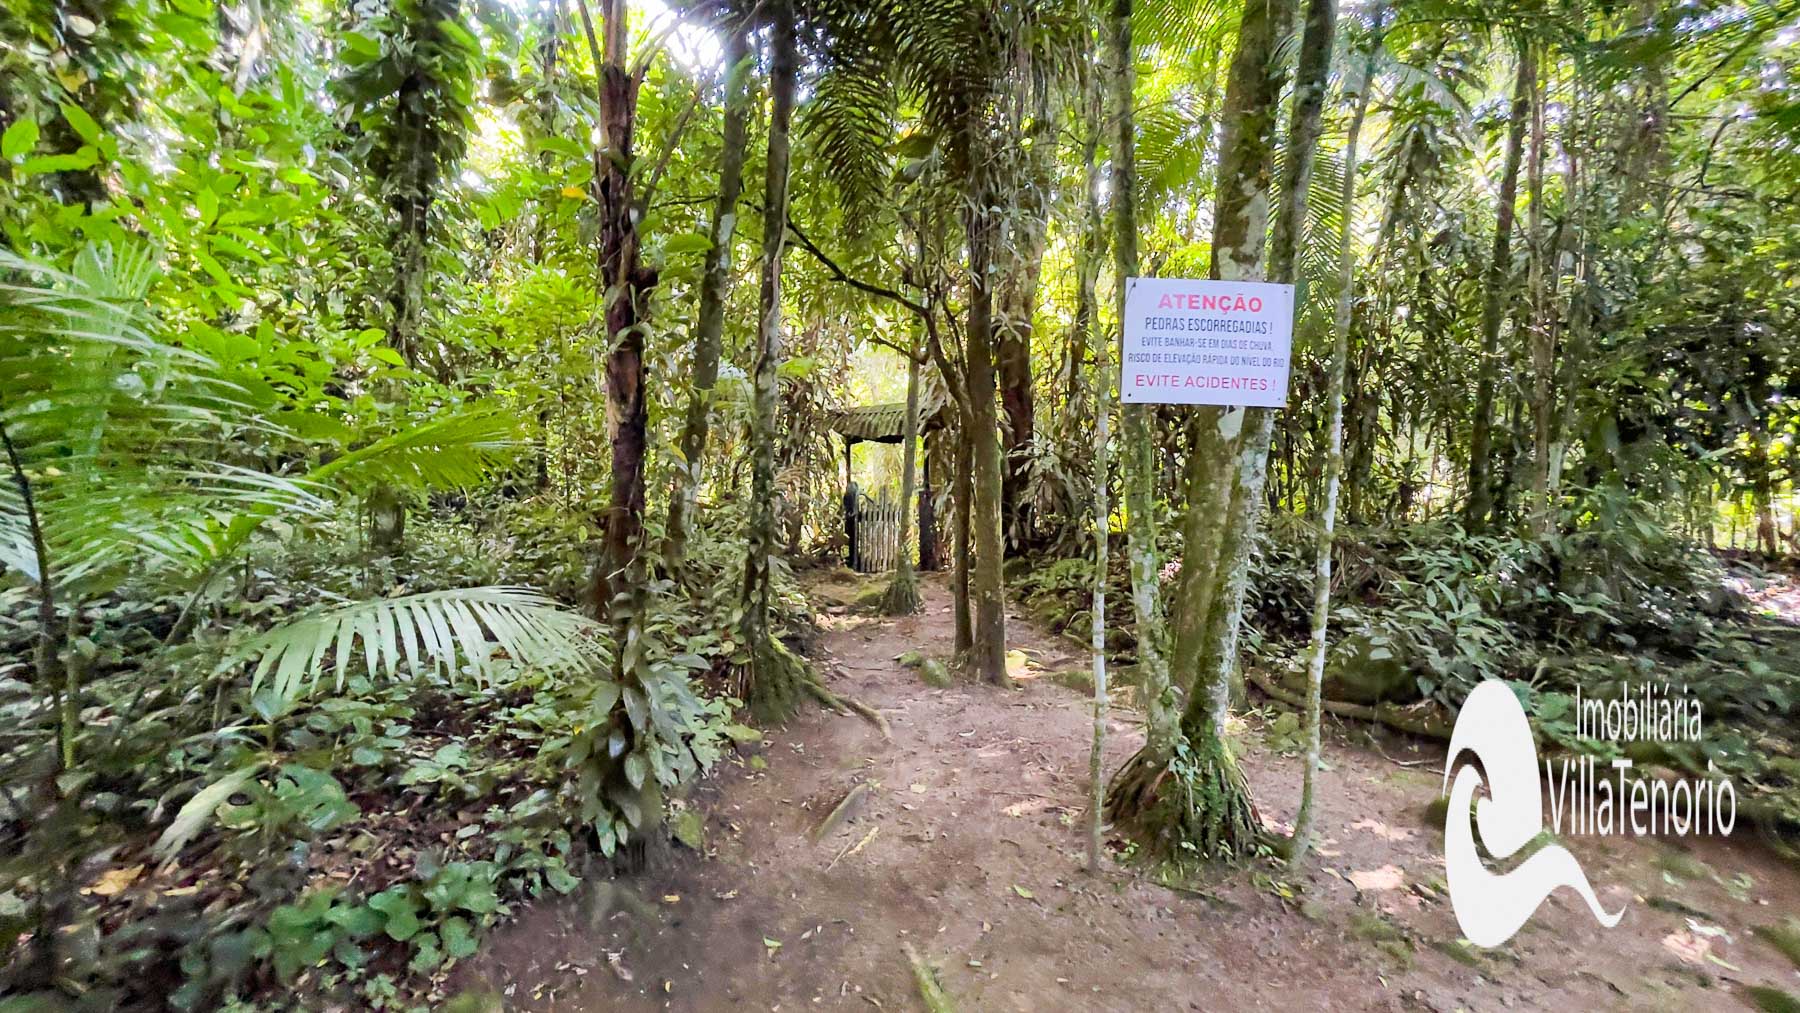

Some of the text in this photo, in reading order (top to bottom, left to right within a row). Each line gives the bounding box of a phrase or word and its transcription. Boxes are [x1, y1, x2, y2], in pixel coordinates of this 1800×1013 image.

[1158, 293, 1262, 315] ATENÇÃO
[1145, 317, 1185, 331] PEDRAS
[1188, 318, 1267, 334] ESCORREGADIAS
[1141, 337, 1163, 347] EVITE
[1165, 337, 1206, 348] BANHAR-SE
[1208, 338, 1219, 349] EM
[1221, 339, 1237, 349] DIAS
[1239, 339, 1248, 350] DE
[1128, 352, 1150, 363] RISCO
[1152, 353, 1162, 363] DE
[1164, 352, 1201, 364] ELEVAÇÃO
[1230, 355, 1240, 366] DO
[1262, 357, 1272, 367] DO
[1273, 357, 1285, 368] RIO
[1135, 375, 1180, 387] EVITE
[1184, 376, 1268, 390] ACIDENTES
